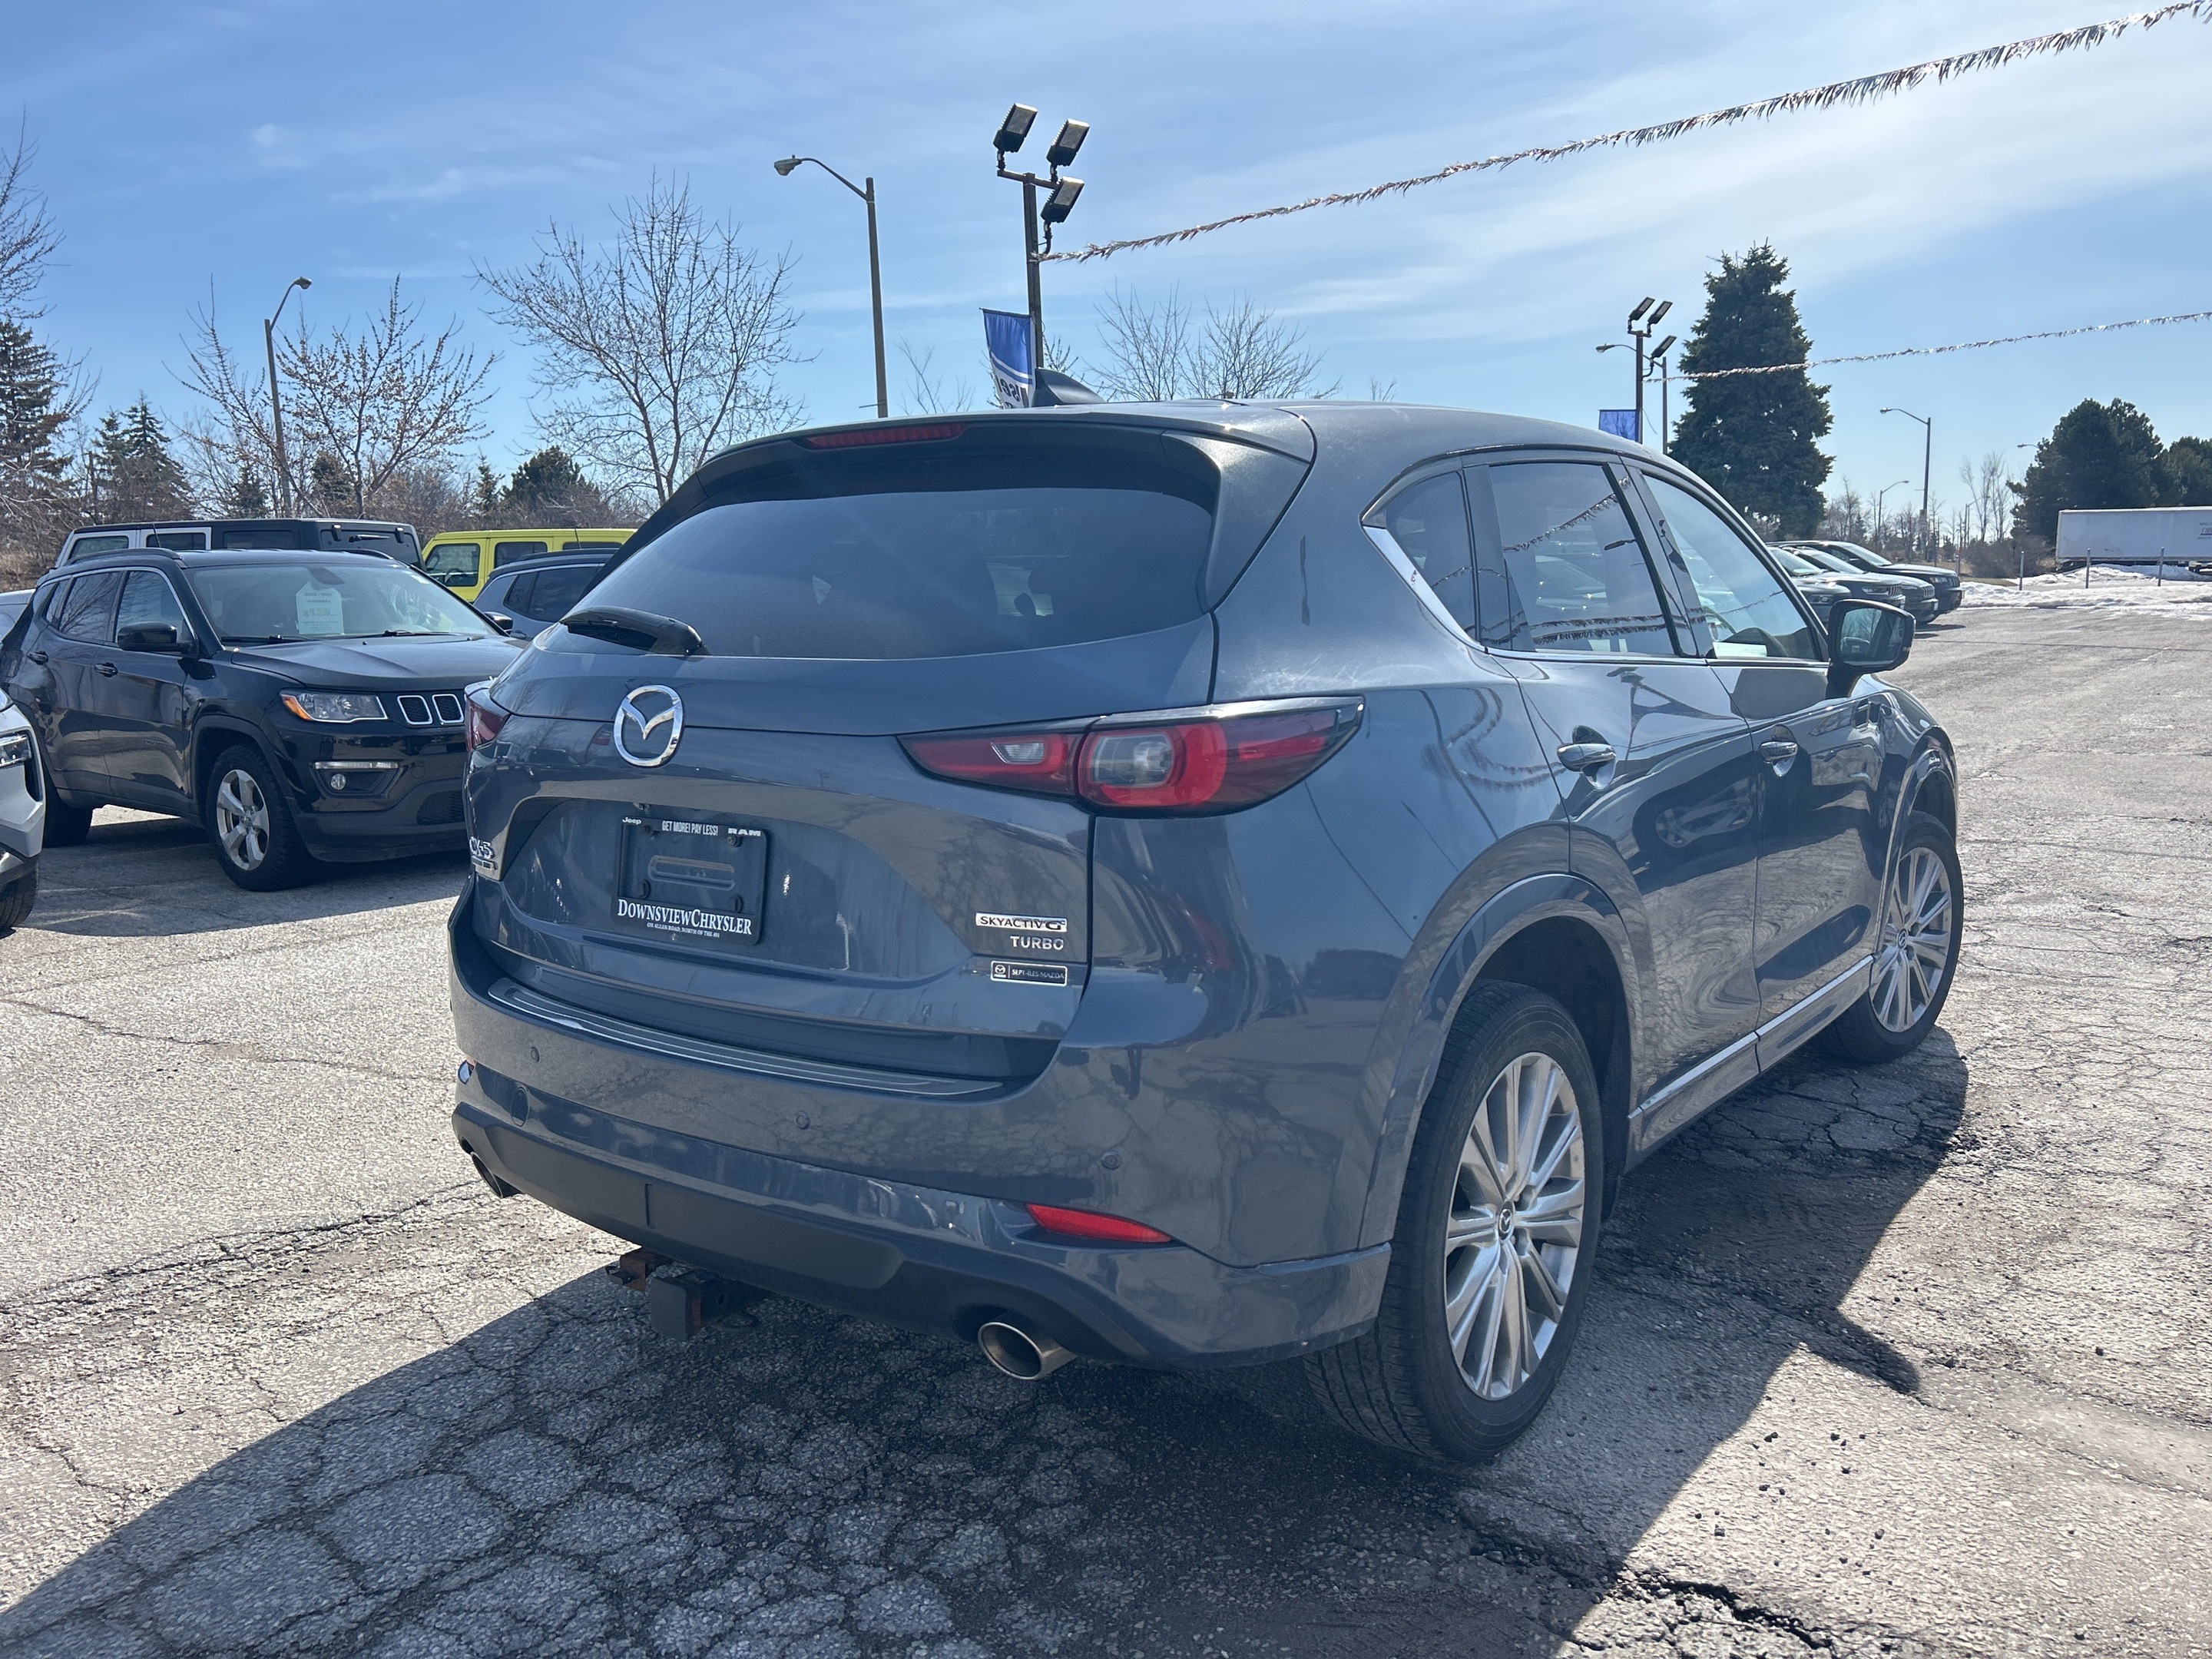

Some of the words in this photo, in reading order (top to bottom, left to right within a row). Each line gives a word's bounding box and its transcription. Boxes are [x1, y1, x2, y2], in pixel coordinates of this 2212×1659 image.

[622, 816, 641, 826] Jeep
[662, 820, 673, 831] GET
[673, 821, 691, 833] MORE!
[691, 823, 702, 834] PAY
[702, 824, 718, 836] LESS!
[728, 827, 761, 836] RAM
[1010, 935, 1065, 951] TURBO
